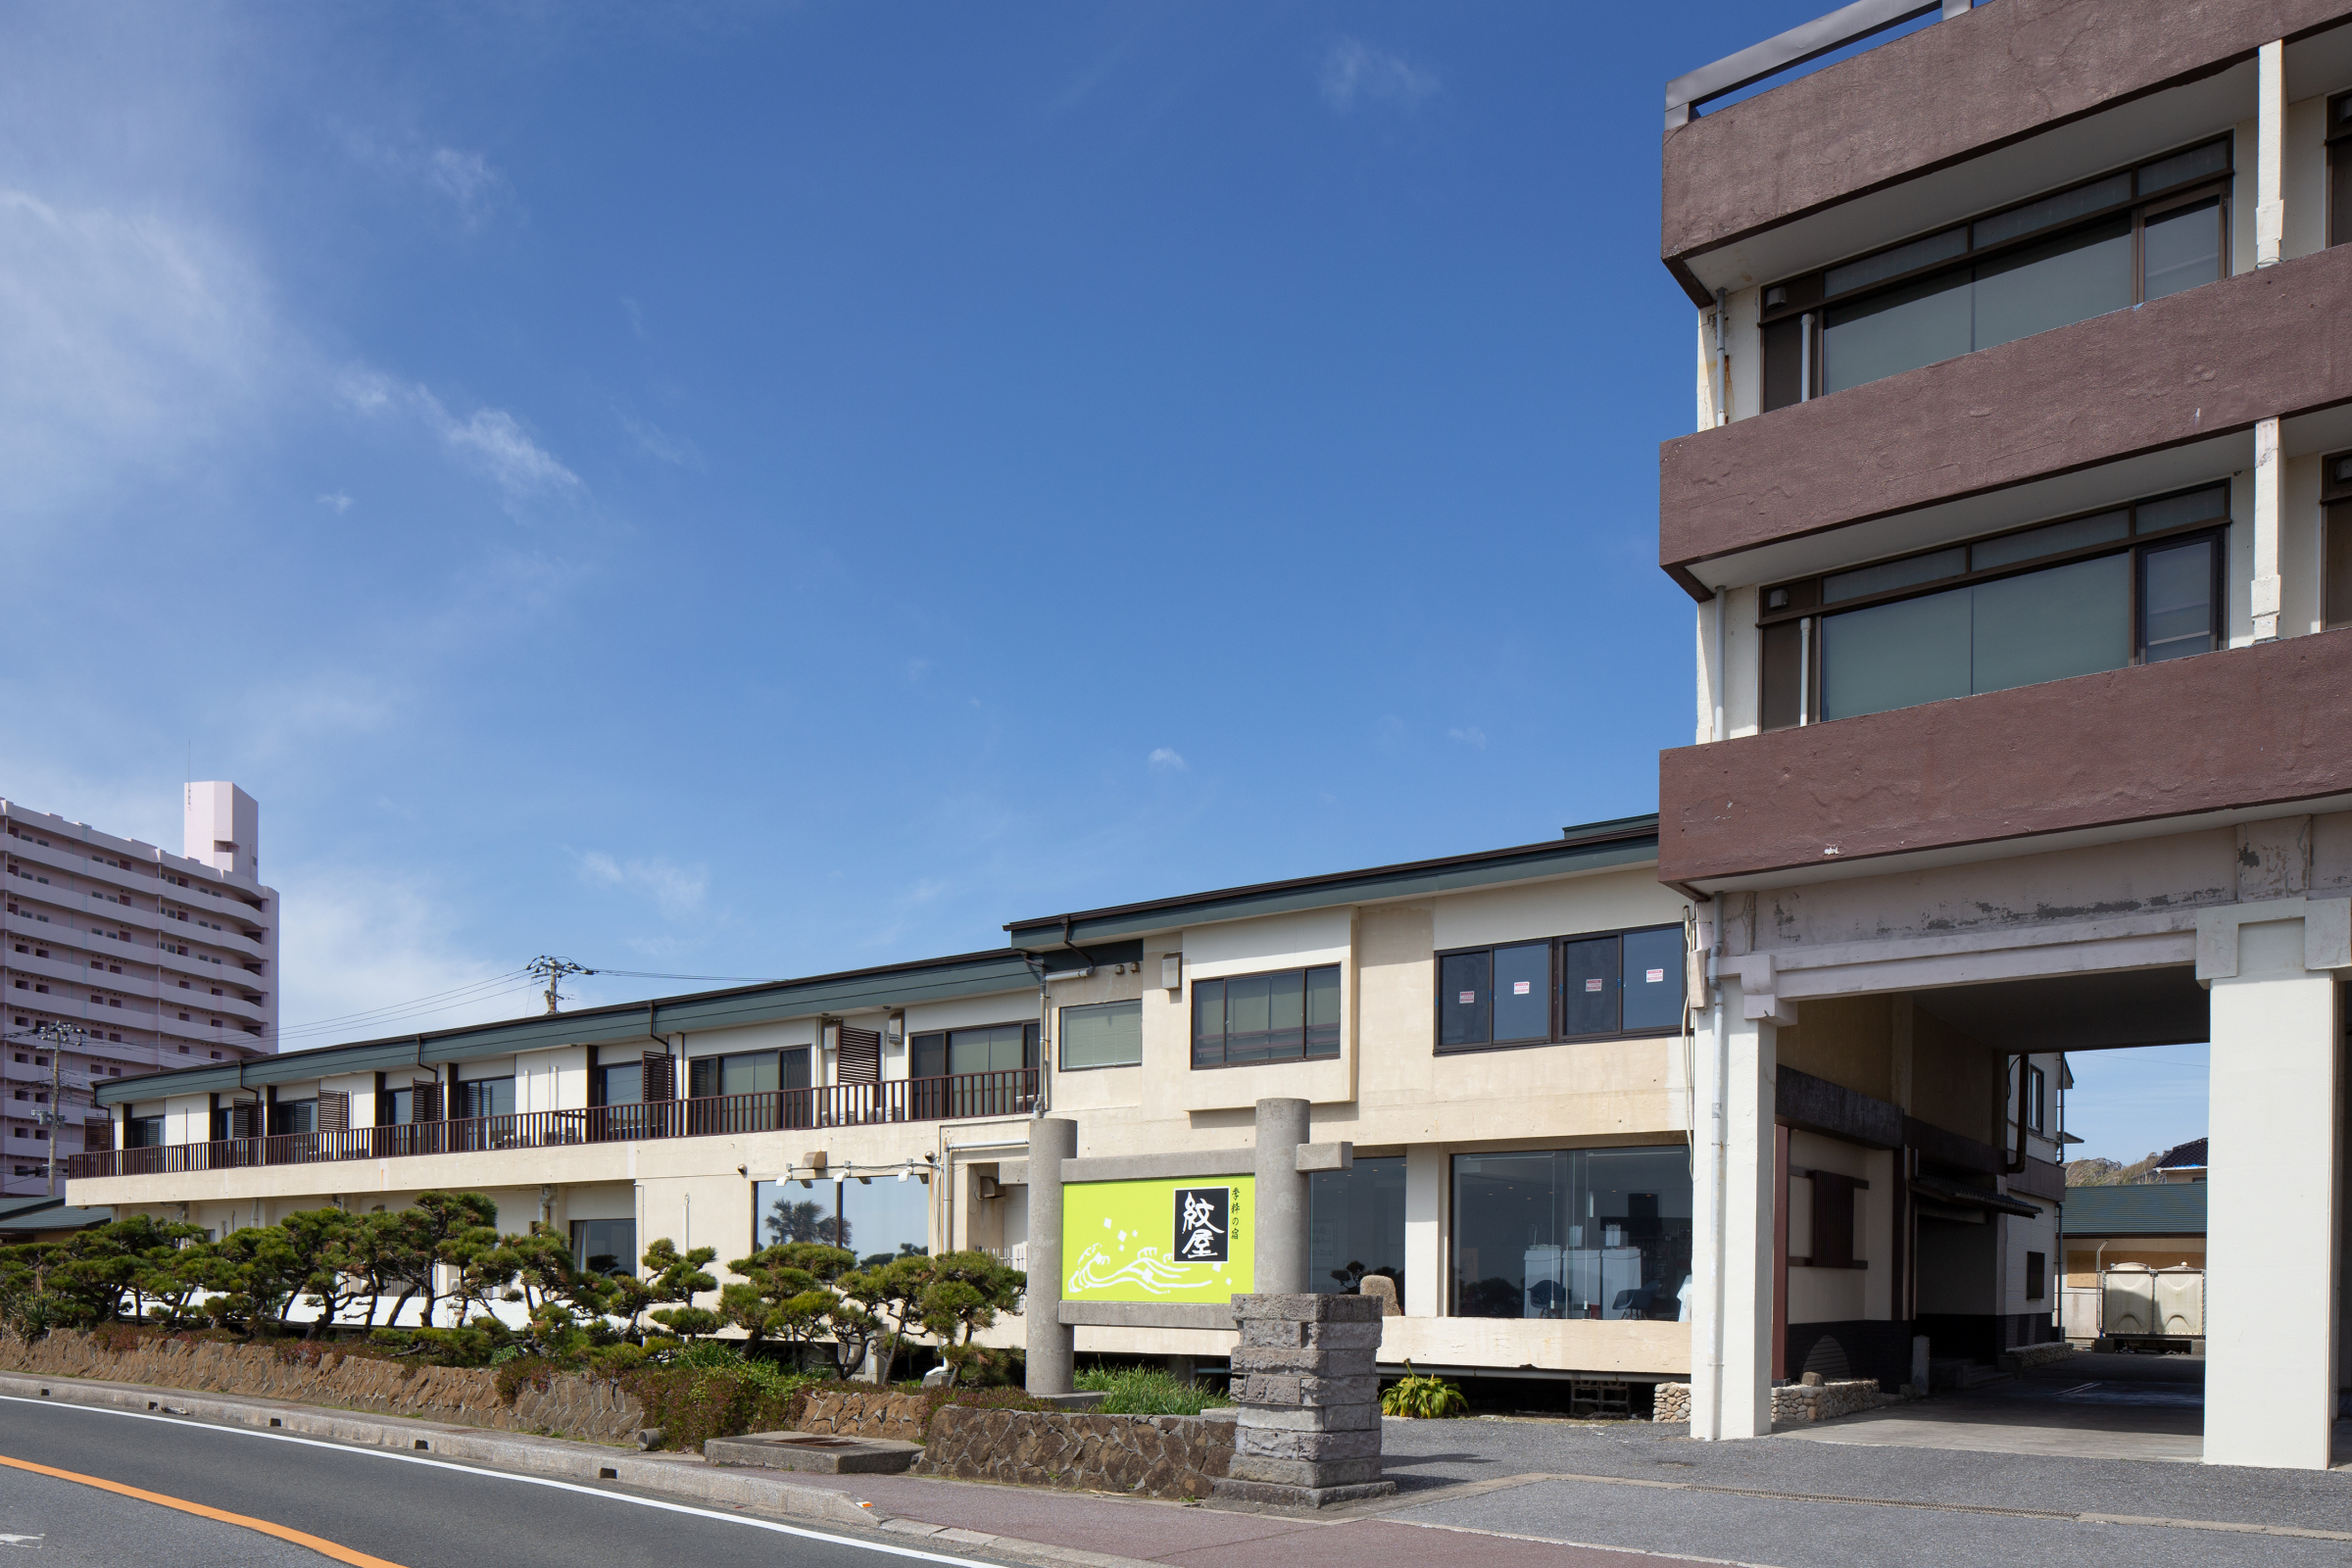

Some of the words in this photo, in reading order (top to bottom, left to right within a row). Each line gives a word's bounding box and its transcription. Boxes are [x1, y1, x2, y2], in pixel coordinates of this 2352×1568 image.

[1181, 1191, 1225, 1259] 紋屋
[1231, 1187, 1241, 1240] 季粋の宿
